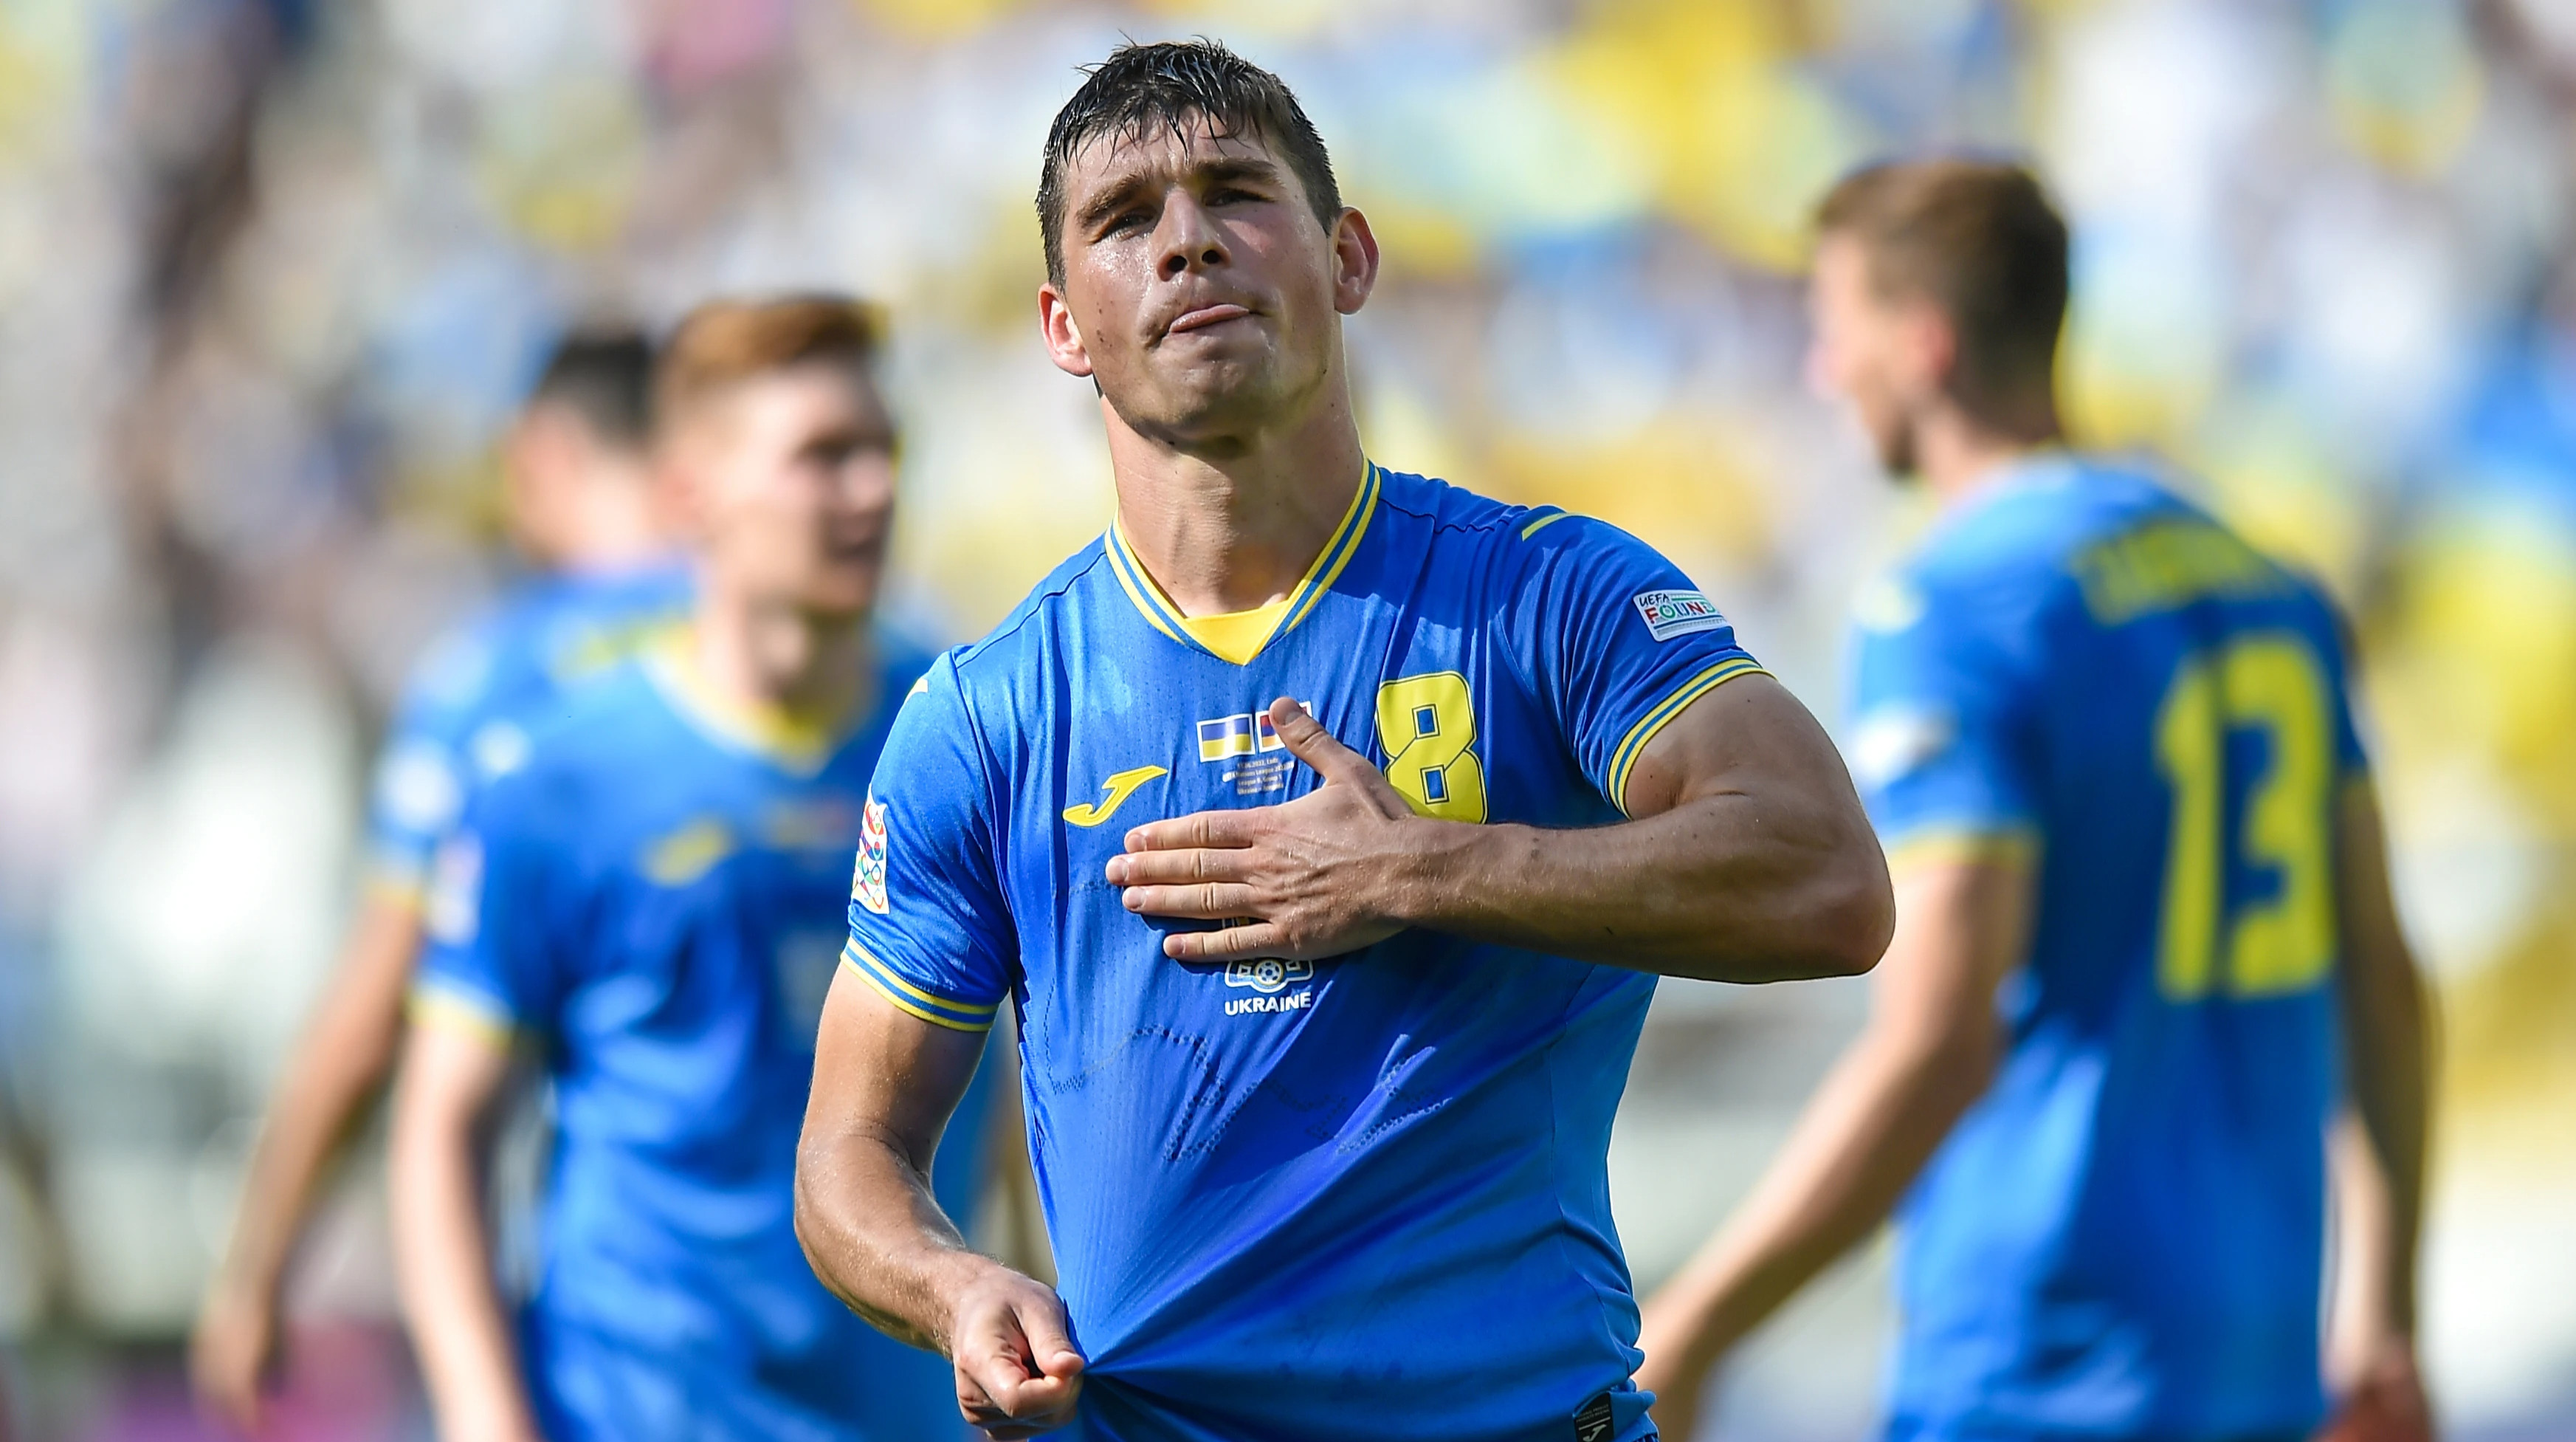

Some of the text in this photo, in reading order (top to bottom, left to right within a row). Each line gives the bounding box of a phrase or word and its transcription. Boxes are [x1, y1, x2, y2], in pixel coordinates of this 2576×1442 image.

[1639, 593, 1670, 607] UEFA
[1374, 670, 1489, 824] 8
[2155, 638, 2332, 998] 13
[1225, 992, 1312, 1016] UKRAINE
